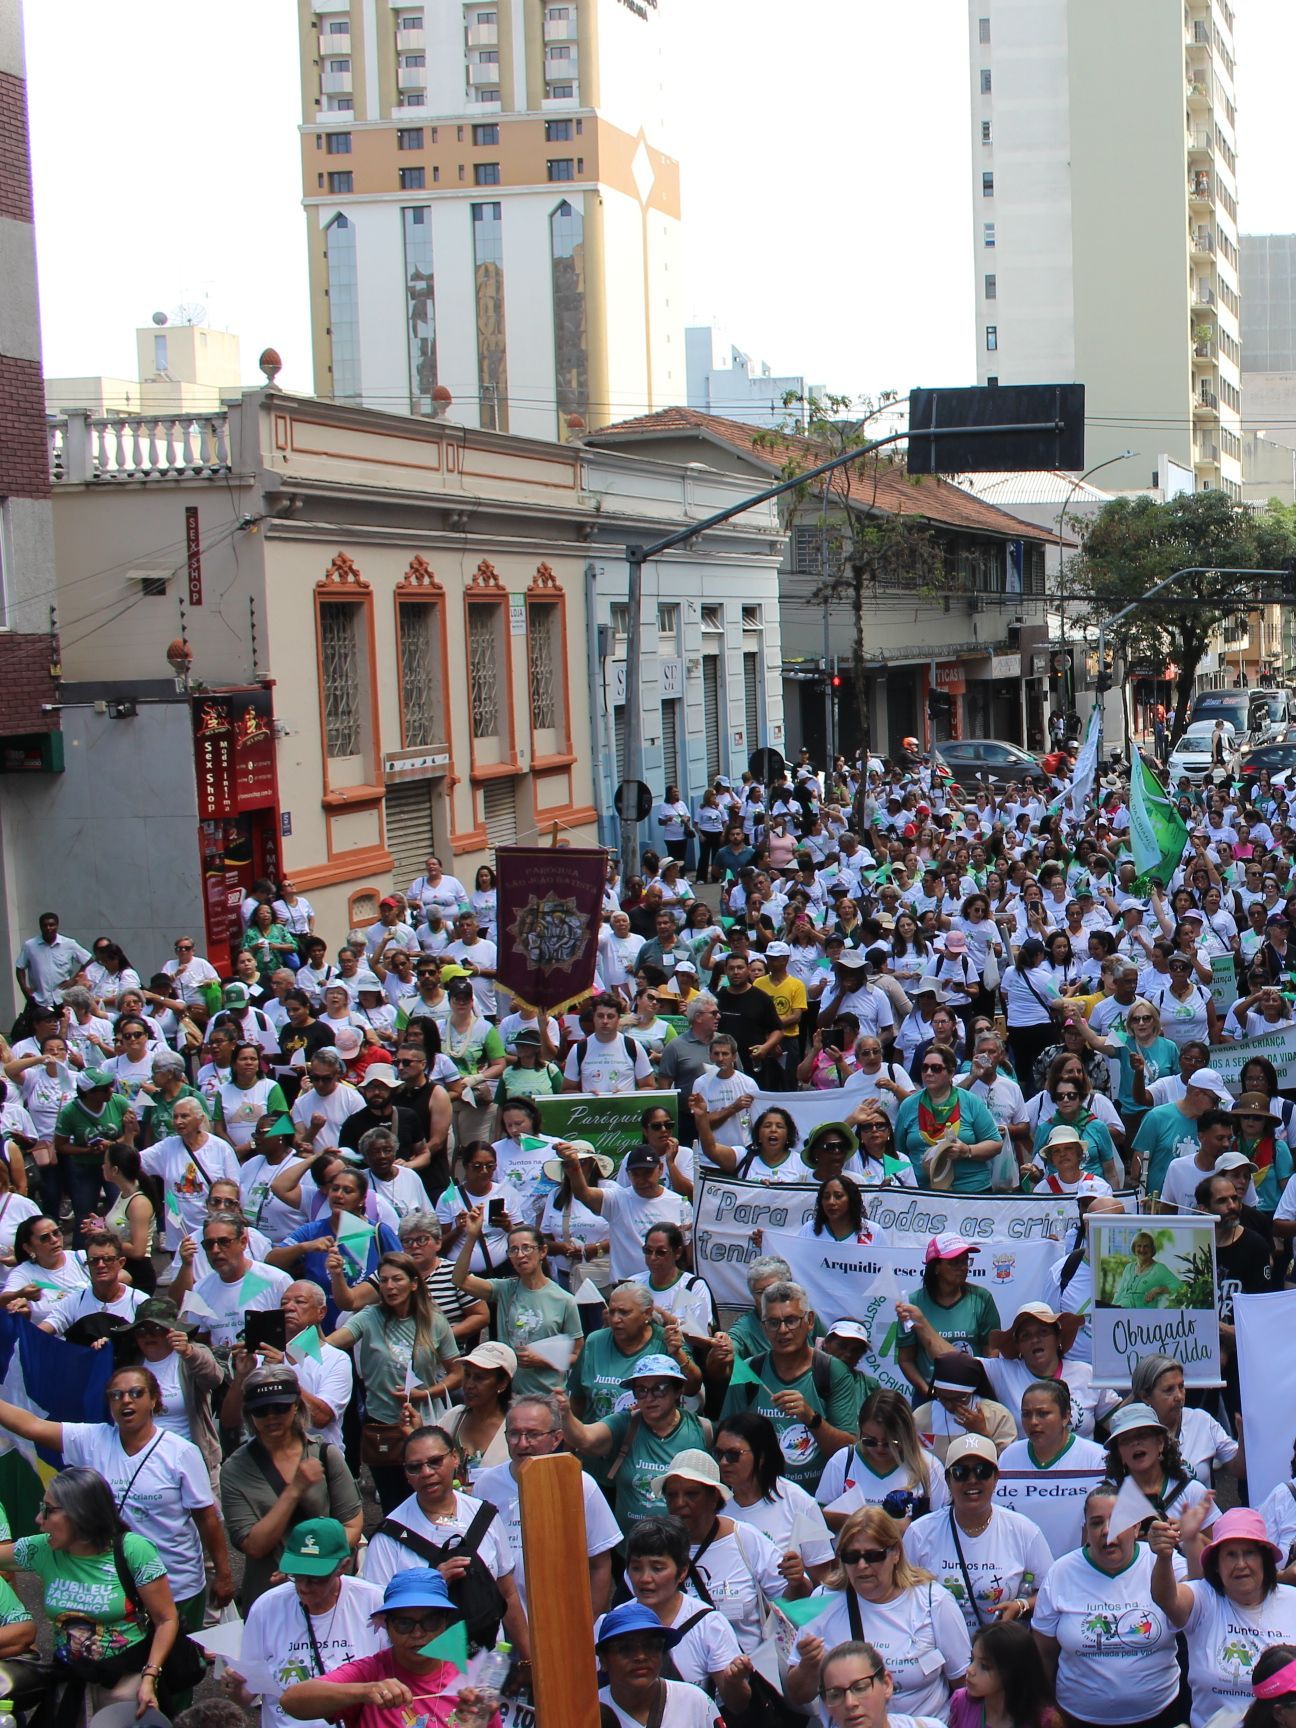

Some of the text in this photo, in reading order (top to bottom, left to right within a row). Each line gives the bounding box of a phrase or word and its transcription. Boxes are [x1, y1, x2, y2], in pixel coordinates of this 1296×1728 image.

[190, 559, 200, 602] SHOP
[511, 607, 524, 617] LOJA
[204, 741, 215, 813] Sex Shop
[1252, 1036, 1286, 1050] CRIANÇA
[1267, 1054, 1278, 1062] DA
[595, 1129, 642, 1152] Migu
[959, 1215, 995, 1239] as
[1112, 1309, 1198, 1355] Obrigado
[865, 1354, 882, 1375] DA
[594, 1374, 624, 1385] Junto
[996, 1484, 1088, 1498] de Pedras
[51, 1578, 112, 1596] JUBILEU
[47, 1589, 112, 1605] PASTORAL
[58, 1601, 111, 1614] CRIANÇA
[885, 1657, 919, 1666] Criança
[1075, 1649, 1121, 1659] Caminhada
